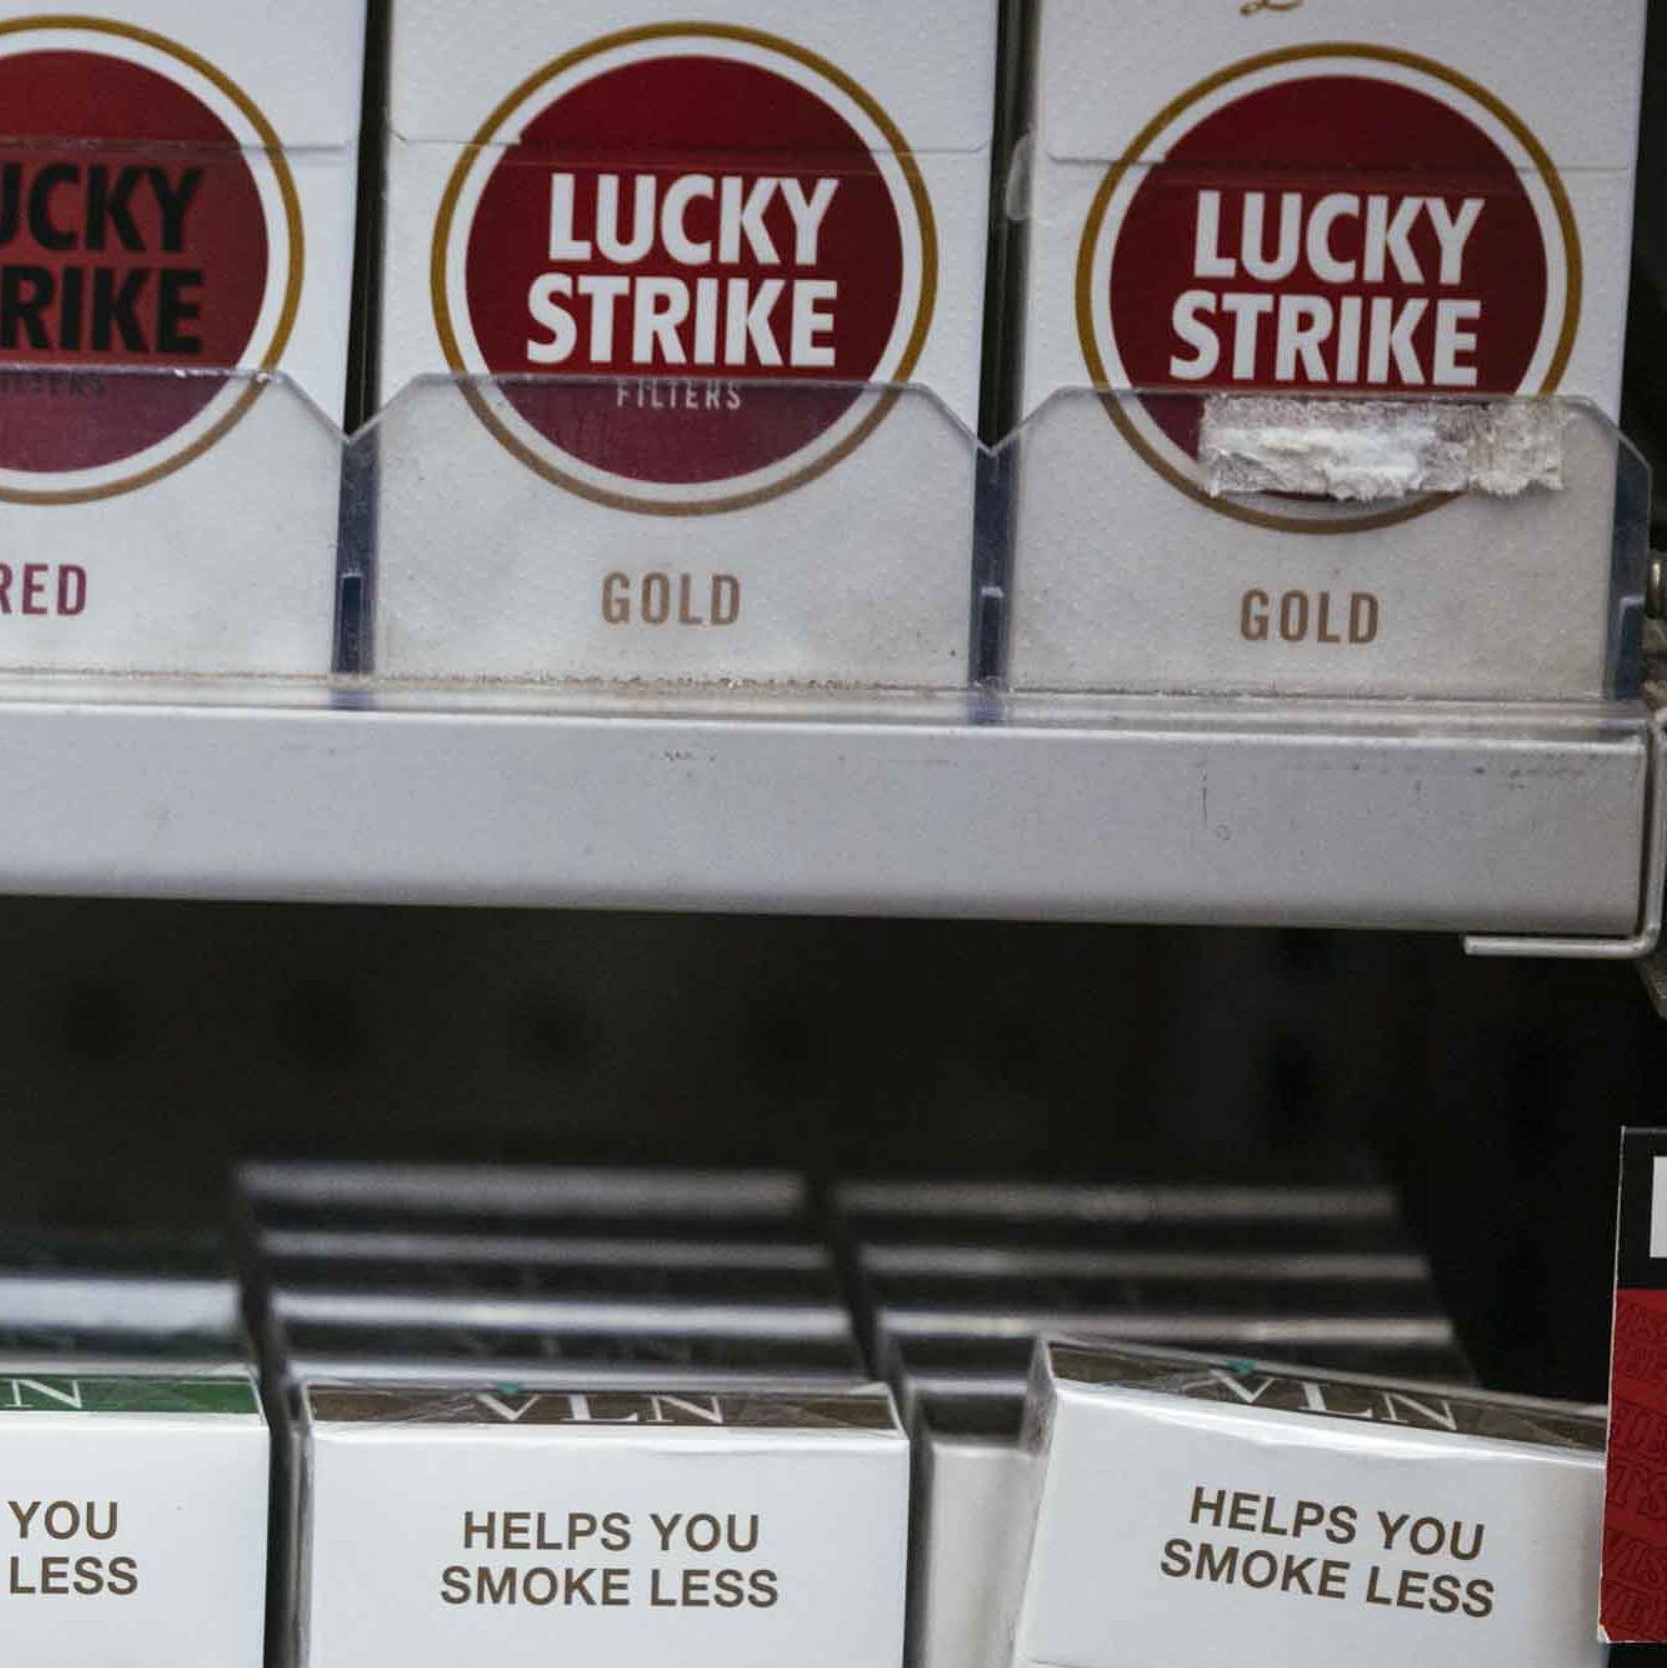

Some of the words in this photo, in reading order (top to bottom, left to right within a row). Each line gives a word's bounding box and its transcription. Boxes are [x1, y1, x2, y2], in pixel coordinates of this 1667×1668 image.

[547, 172, 840, 267] LUCKY
[1193, 190, 1485, 286] LUCKY
[526, 273, 839, 368] STRIKE
[1168, 290, 1482, 387] STRIKE
[616, 379, 742, 410] FILTERS
[601, 571, 742, 627] GOLD
[1239, 587, 1380, 645] GOLD
[476, 1394, 725, 1425] VLN
[1210, 1368, 1458, 1431] VLN
[8, 1500, 119, 1541] YOU
[462, 1510, 632, 1552] HELPS
[649, 1512, 761, 1553] YOU
[1188, 1485, 1360, 1545] HELPS
[1375, 1510, 1486, 1562] YOU
[8, 1555, 139, 1595] LESS
[439, 1566, 630, 1607] SMOKE
[649, 1568, 780, 1608] LESS
[1159, 1537, 1351, 1600] SMOKE
[1365, 1563, 1496, 1619] LESS
